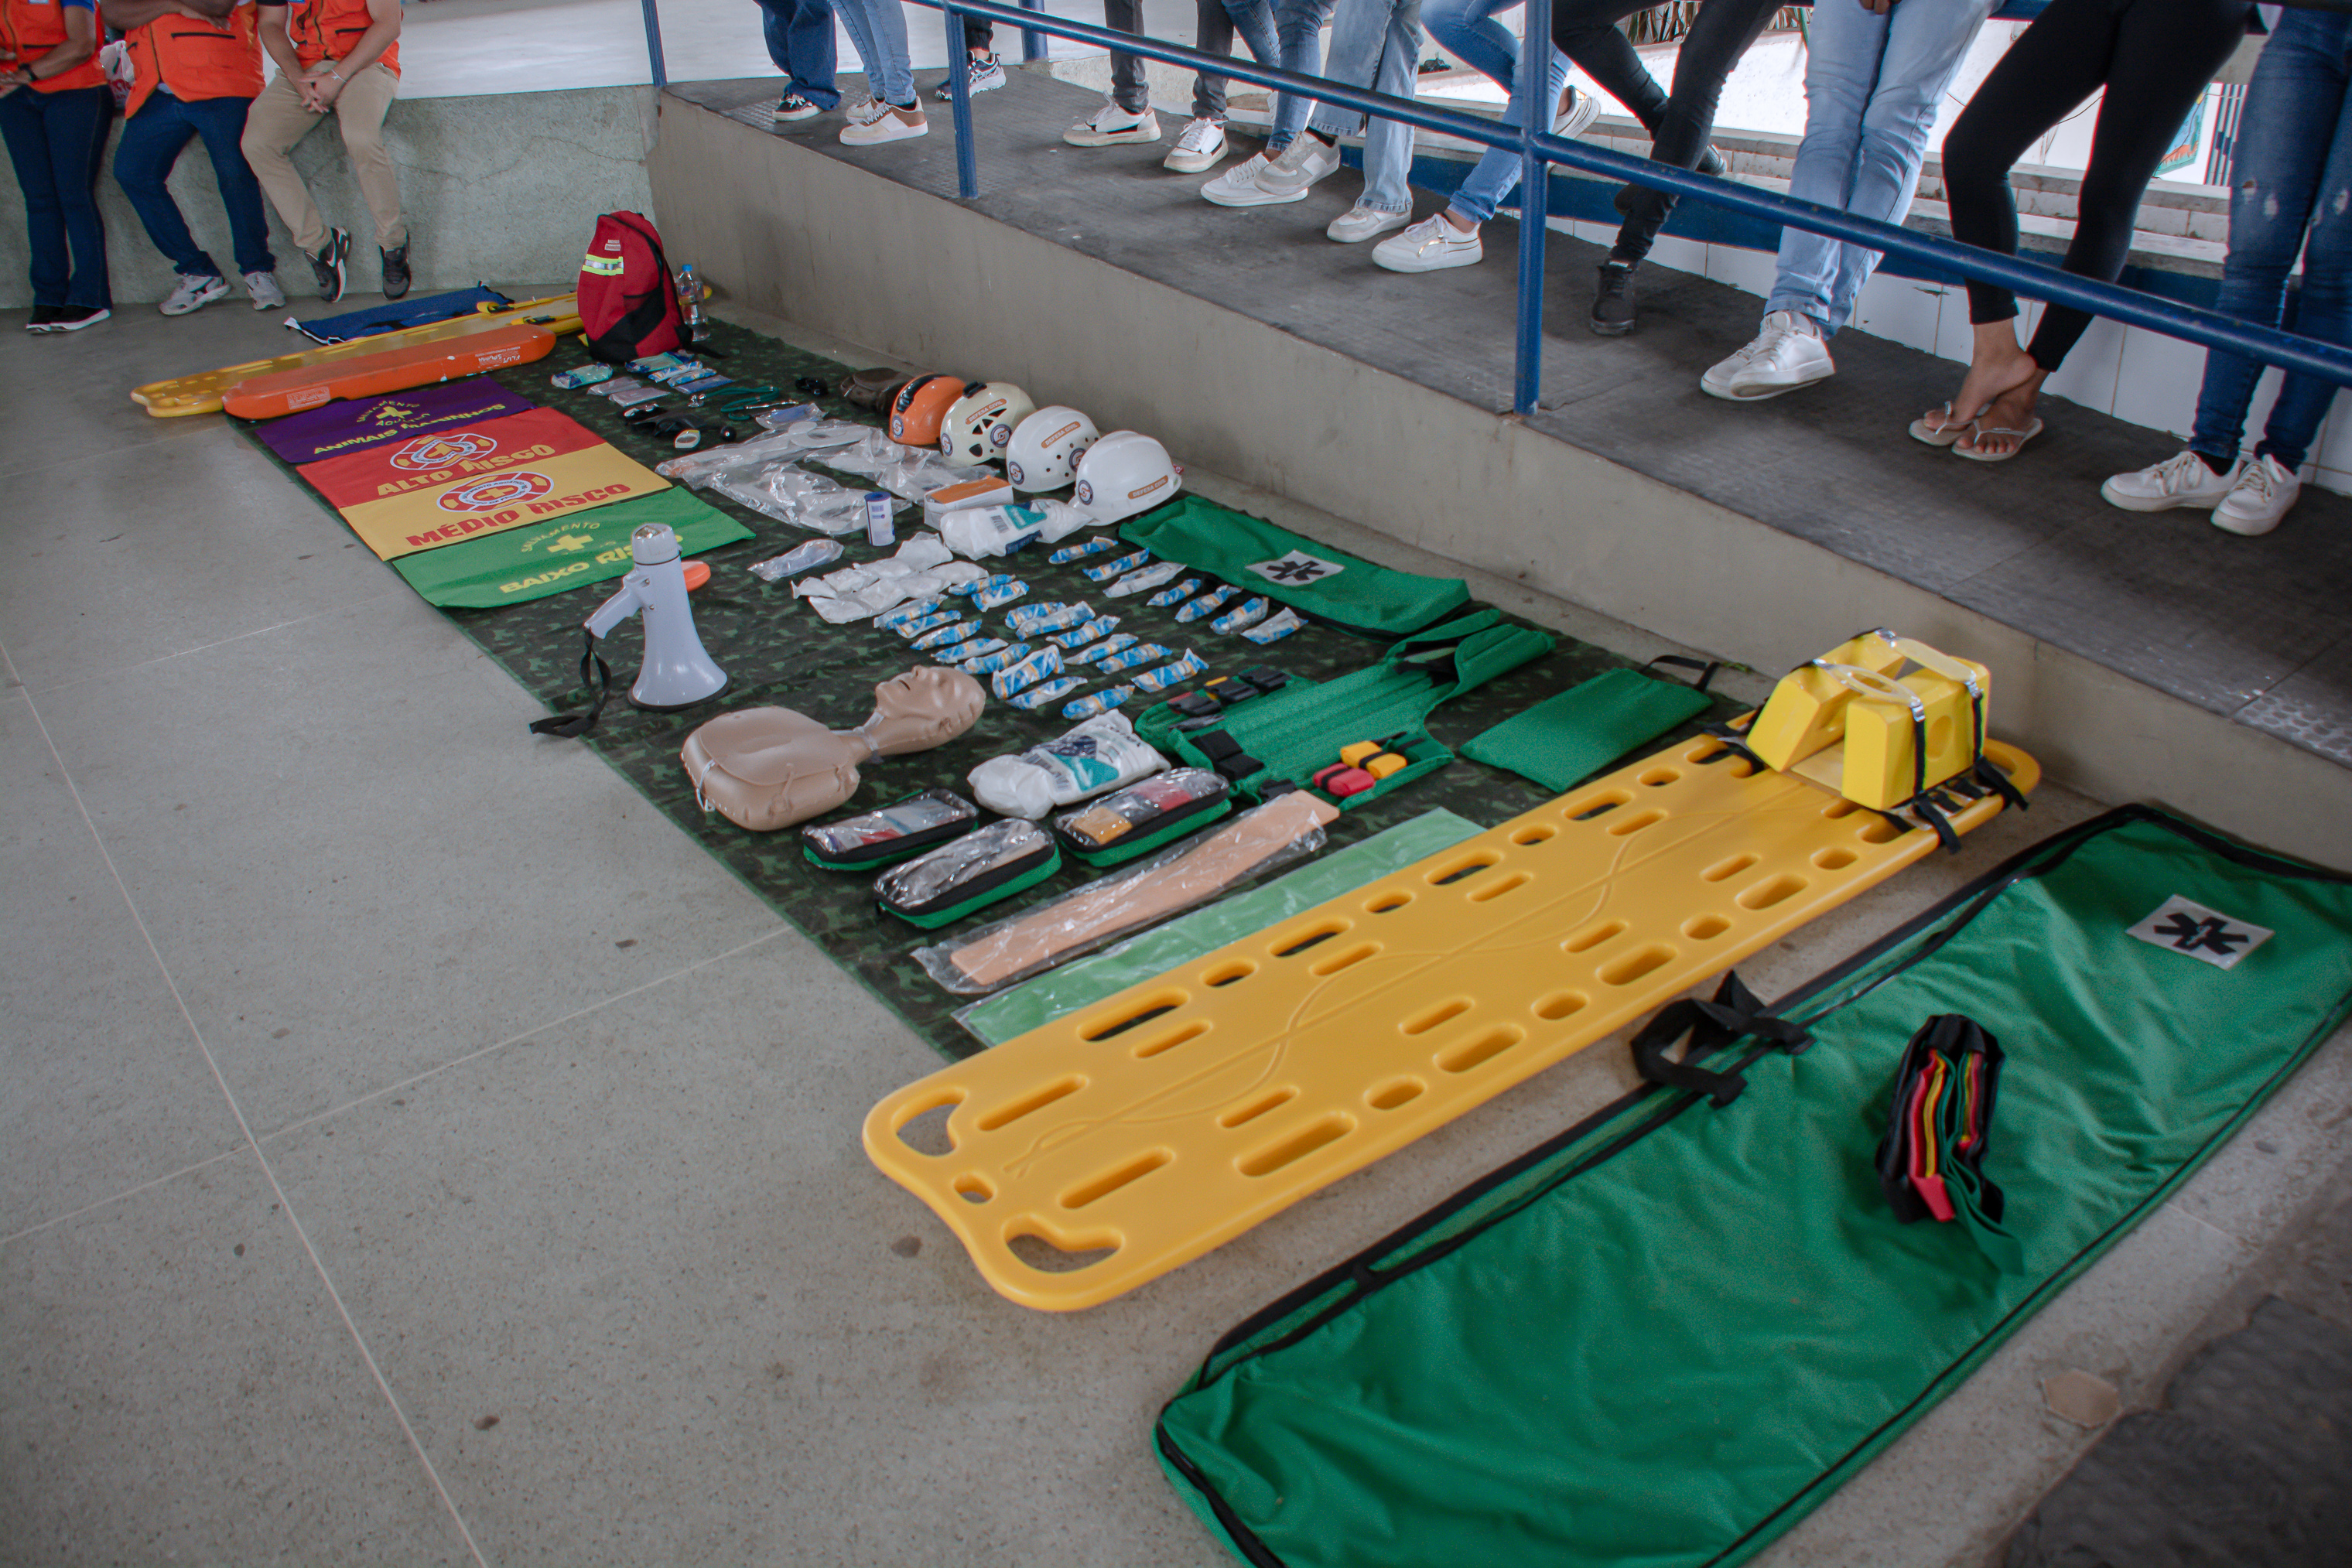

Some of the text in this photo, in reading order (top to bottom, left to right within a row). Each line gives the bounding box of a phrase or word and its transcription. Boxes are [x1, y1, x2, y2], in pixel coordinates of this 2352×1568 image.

[969, 400, 1003, 422] DEFESA CIVIL
[313, 429, 398, 454] ANIMAIS
[377, 470, 453, 496] ALTO
[459, 444, 556, 473] RISCO
[1132, 484, 1154, 497] DEFESA
[405, 483, 631, 546] MÉDIO RISCO
[500, 562, 590, 593] BAIXO
